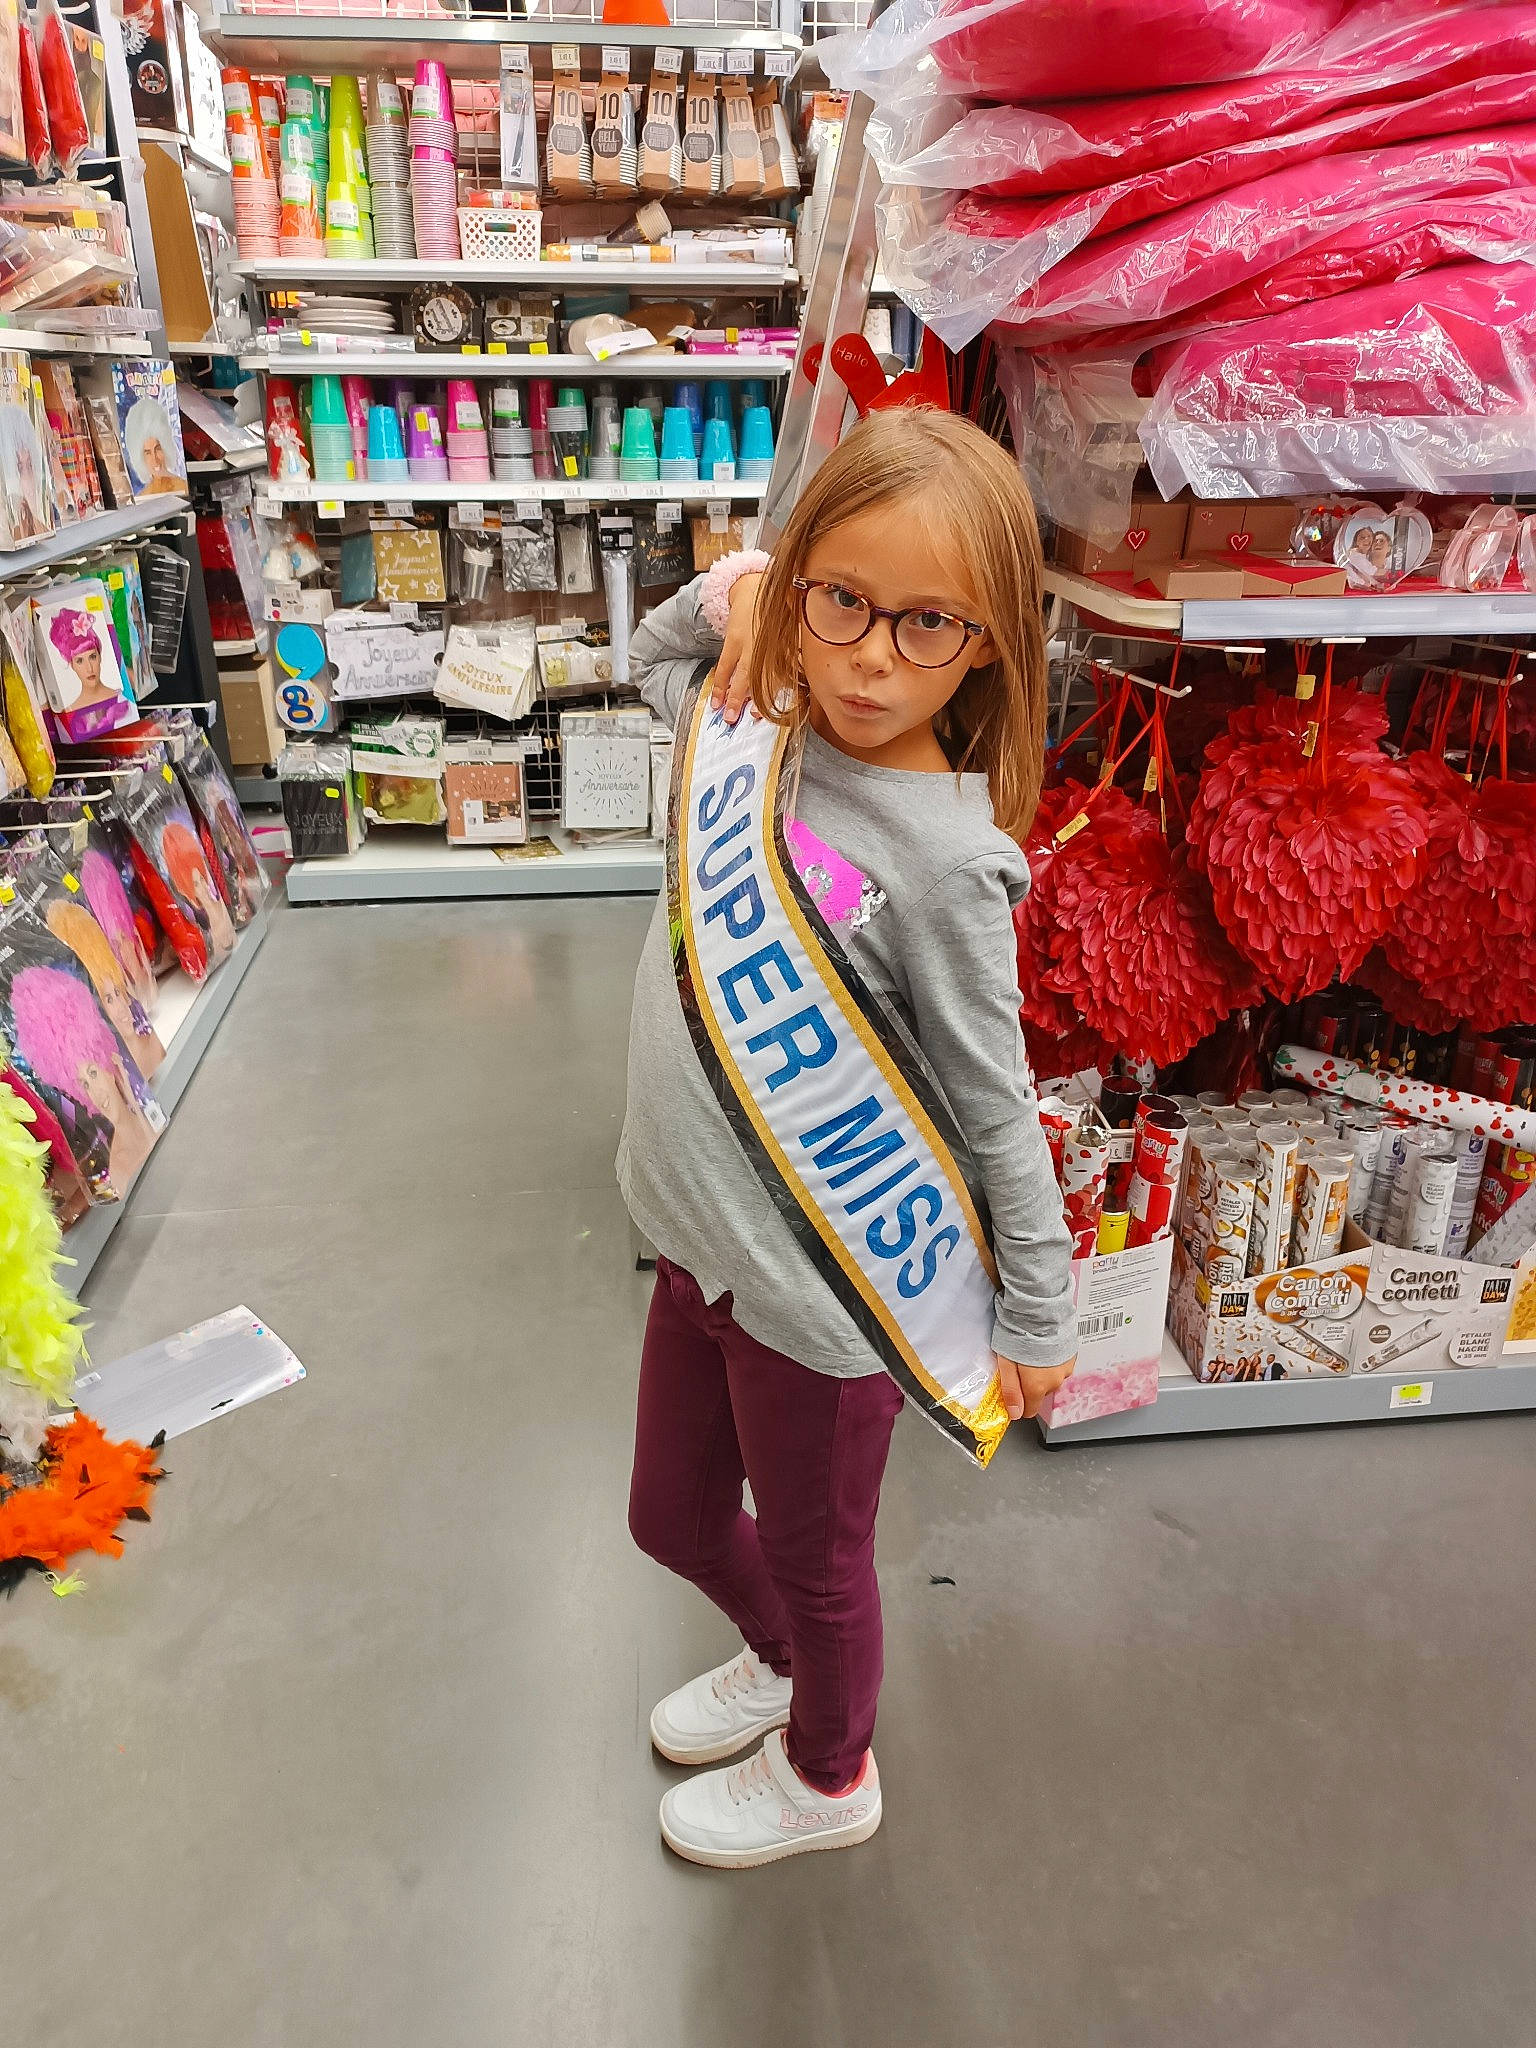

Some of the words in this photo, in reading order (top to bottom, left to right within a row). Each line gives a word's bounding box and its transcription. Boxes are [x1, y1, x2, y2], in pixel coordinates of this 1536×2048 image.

[557, 90, 579, 118] 10
[599, 92, 619, 120] 10
[652, 90, 673, 117] 10
[689, 97, 710, 124] 10
[728, 98, 749, 123] 10
[754, 105, 772, 133] 10
[834, 345, 869, 368] Hallo
[361, 637, 421, 673] Joyeux
[460, 659, 504, 684] JOYEUX
[282, 684, 314, 723] 60
[579, 777, 640, 794] Anniversaire
[695, 762, 839, 1094] SUPER
[798, 1094, 961, 1299] MISS
[1278, 1274, 1348, 1293] Canon
[1390, 1267, 1459, 1285] Canon
[1484, 1280, 1511, 1292] PARTY
[1222, 1293, 1248, 1306] PARTY
[1270, 1288, 1351, 1310] confetti
[1381, 1283, 1461, 1302] confetti
[1482, 1291, 1501, 1300] DAY
[1221, 1305, 1240, 1315] DAY
[1457, 1344, 1490, 1352] NACRÉ
[1459, 1338, 1490, 1346] BLANC
[778, 1803, 868, 1830] Levi's
